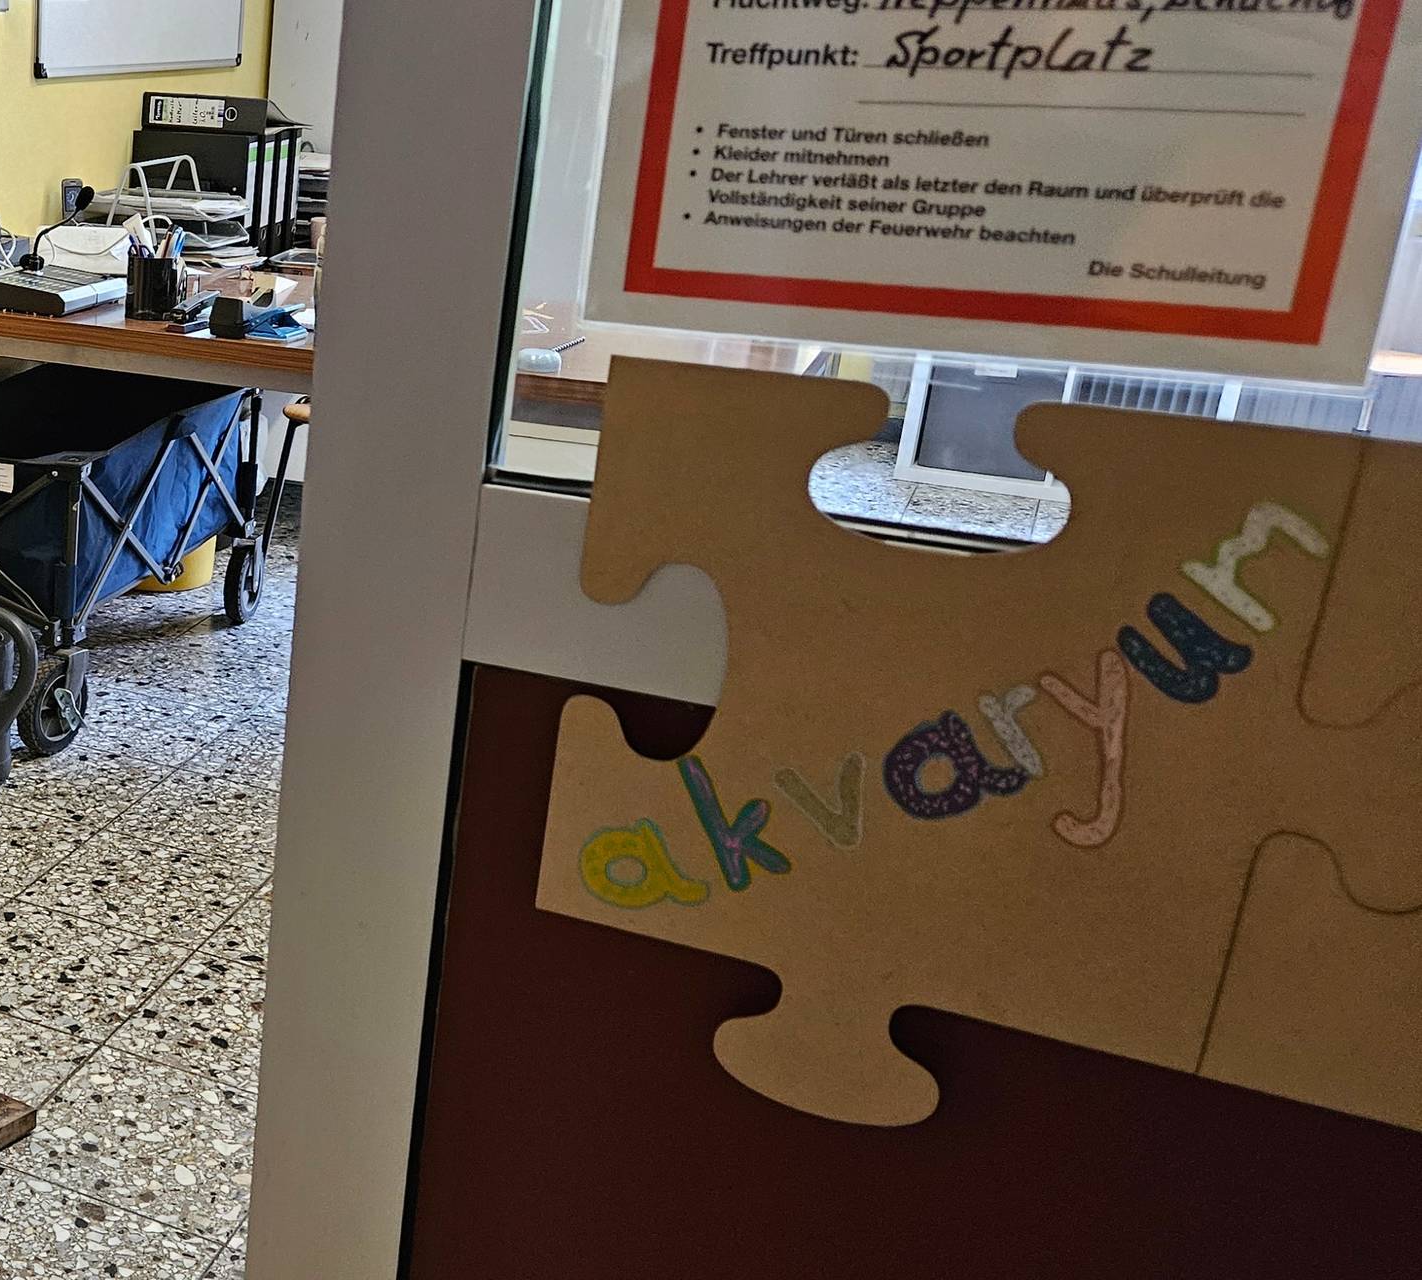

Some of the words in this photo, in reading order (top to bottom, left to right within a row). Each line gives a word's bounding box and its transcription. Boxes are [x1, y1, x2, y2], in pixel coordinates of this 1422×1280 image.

[706, 42, 859, 69] Treffpunkt:
[885, 25, 1153, 79] Sportplatz
[717, 124, 786, 140] Fenster
[792, 127, 827, 142] und
[833, 127, 887, 144] Türen
[893, 129, 990, 147] schließen
[713, 145, 780, 162] Kleider
[783, 149, 890, 166] mitnehmen
[710, 167, 743, 183] Der
[747, 169, 808, 186] Lehrer
[812, 172, 877, 189] verläßt
[882, 176, 910, 191] als
[915, 177, 978, 194] letzter
[984, 179, 1022, 196] den
[1028, 181, 1089, 199] Raum
[1094, 185, 1137, 201] und
[1141, 186, 1245, 207] überprüft
[1249, 191, 1286, 208] die
[708, 188, 843, 211] Vollständigkeit
[847, 198, 907, 214] seiner
[912, 200, 986, 219] Gruppe
[704, 210, 826, 232] Anweisungen
[832, 219, 864, 233] der
[869, 220, 974, 240] Feuerwehr
[979, 226, 1076, 245] beachten
[1087, 260, 1124, 277] Die
[1130, 262, 1267, 290] Schulleitung
